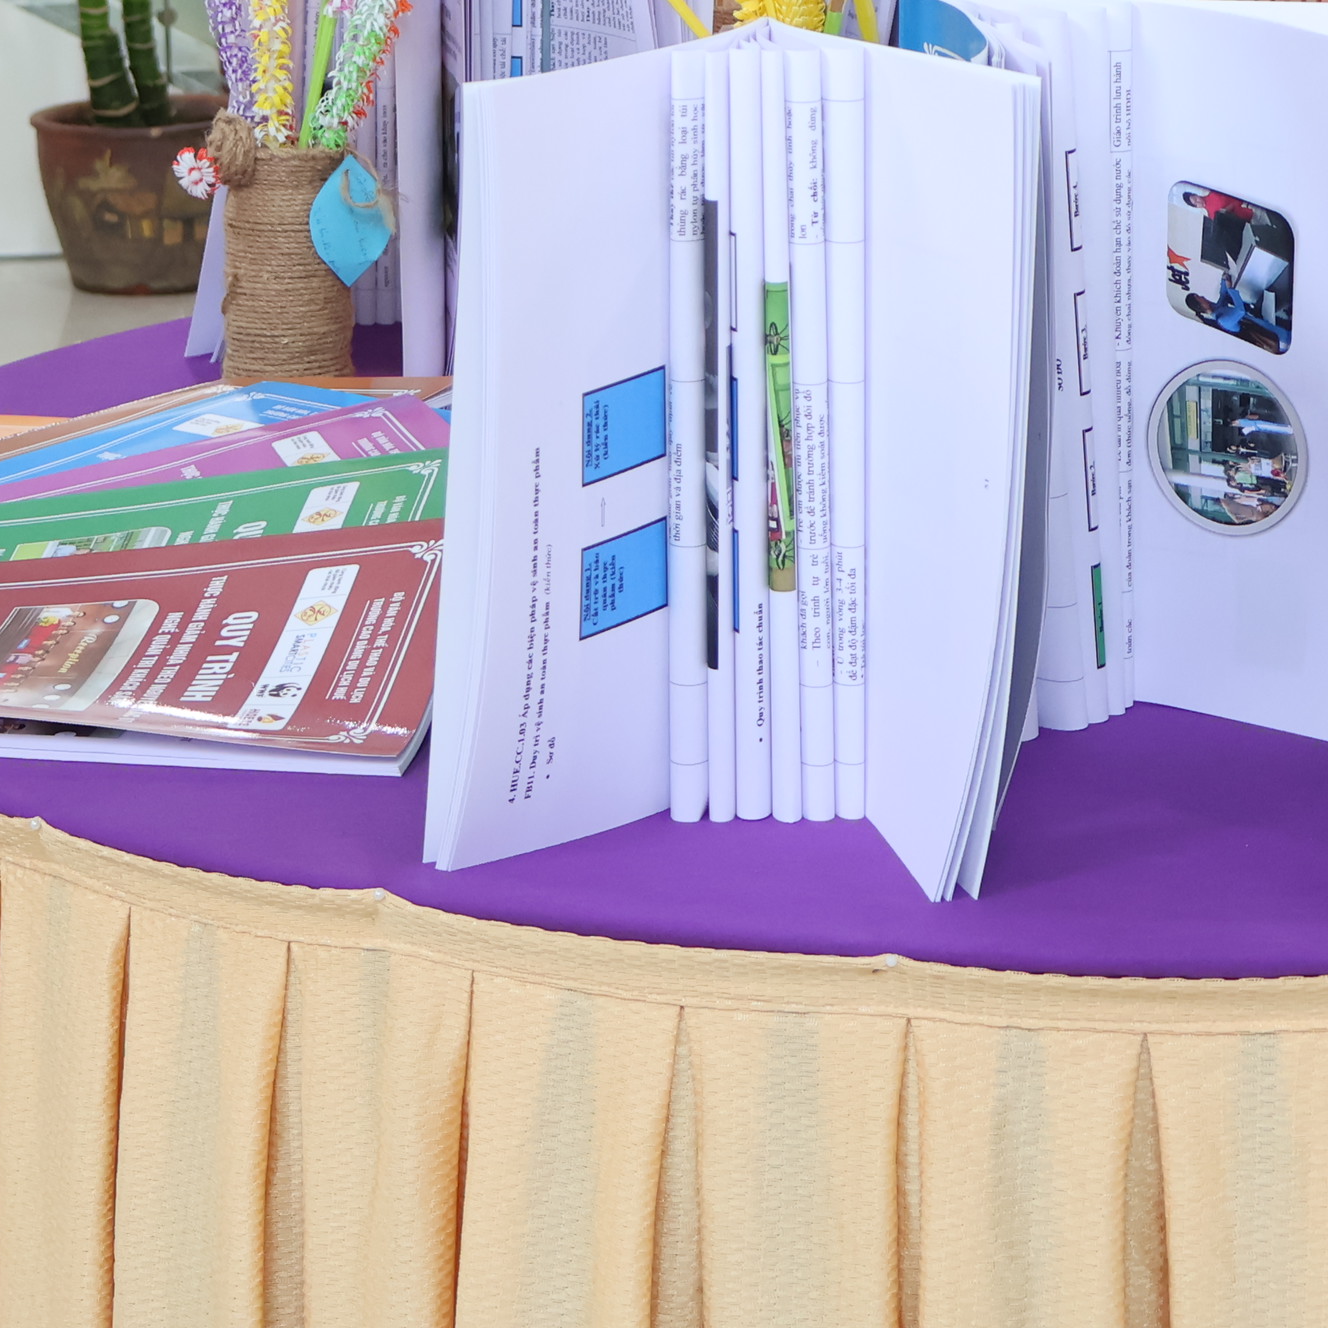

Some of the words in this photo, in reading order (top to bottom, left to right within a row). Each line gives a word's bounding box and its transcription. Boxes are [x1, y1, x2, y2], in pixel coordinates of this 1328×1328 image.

[1112, 62, 1122, 84] hành
[679, 104, 688, 117] túi
[1112, 103, 1122, 123] trình
[678, 126, 688, 144] loại
[690, 124, 698, 144] sinh
[1112, 126, 1122, 148] Giáo
[809, 140, 818, 169] không
[679, 186, 687, 200] rác
[691, 208, 699, 236] nylon
[799, 224, 807, 239] lon
[532, 482, 541, 507] thực
[806, 479, 816, 502] tránh
[673, 500, 684, 520] gian
[531, 511, 540, 534] toàn
[806, 520, 816, 544] trước
[532, 538, 539, 551] an
[530, 555, 538, 578] sinh
[529, 580, 539, 592] vệ
[812, 576, 822, 586] tự
[191, 598, 218, 621] HÀNH
[528, 596, 539, 623] pháp
[754, 603, 764, 633] chuẩn
[811, 596, 820, 618] trình
[214, 611, 259, 647] QUY
[359, 626, 374, 640] CAO
[526, 626, 537, 650] biện
[812, 627, 821, 650] Theo
[539, 633, 550, 656] thực
[756, 636, 764, 650] tác
[346, 660, 360, 670] DU
[366, 648, 383, 666] THAO
[524, 653, 534, 670] các
[756, 653, 764, 675] thao
[179, 651, 240, 702] TRÌNH
[539, 658, 547, 681] toàn
[356, 677, 371, 687] DU
[521, 672, 534, 701] dụng
[539, 684, 546, 695] an
[756, 678, 764, 703] trình
[536, 698, 545, 718] sinh
[756, 705, 766, 727] Quy
[534, 721, 543, 732] vệ
[529, 750, 540, 770] Duy
